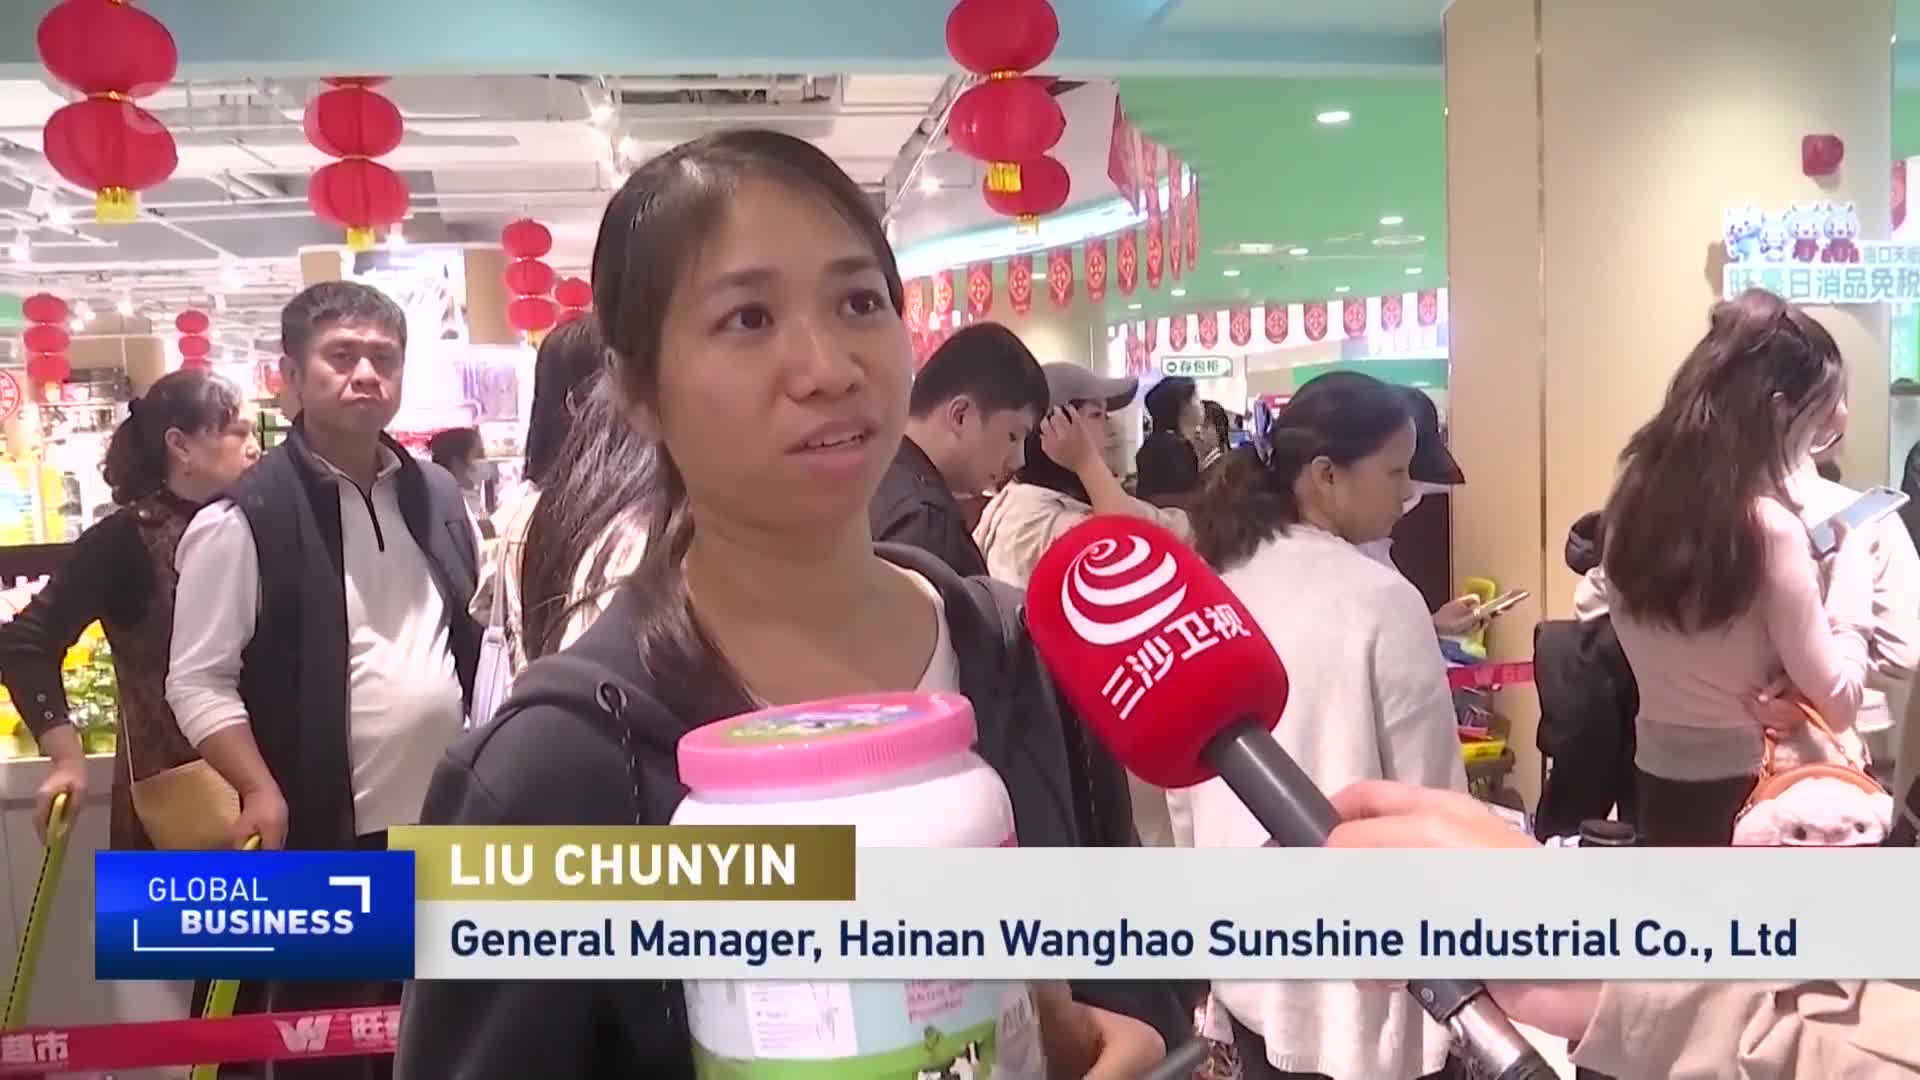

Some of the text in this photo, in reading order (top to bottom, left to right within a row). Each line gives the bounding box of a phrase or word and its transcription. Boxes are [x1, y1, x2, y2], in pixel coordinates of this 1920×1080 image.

[1180, 359, 1220, 373] 存包柜
[1101, 603, 1252, 720] 三沙卫视
